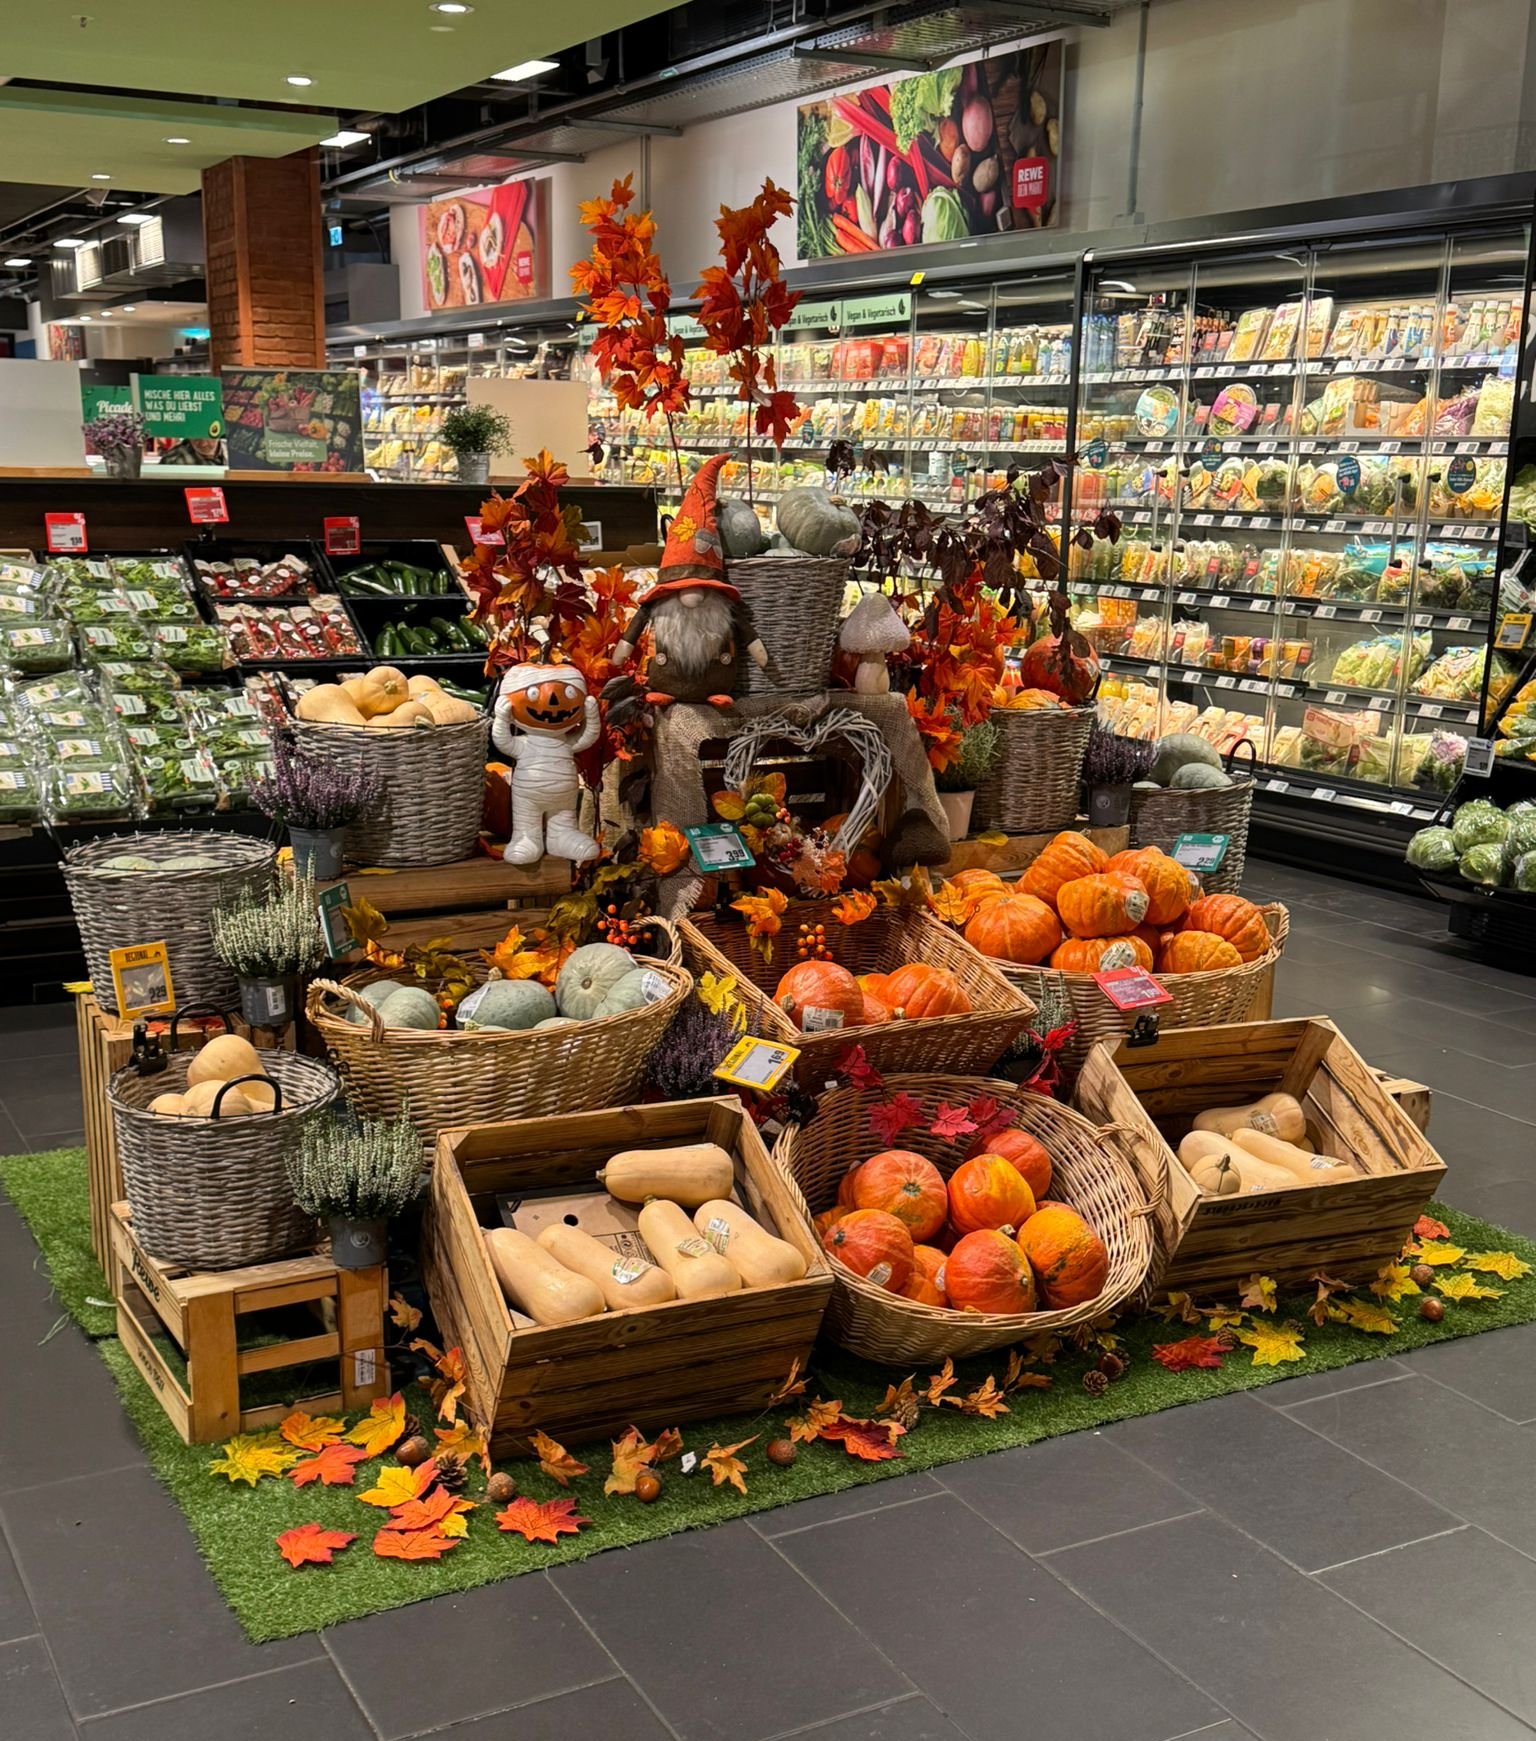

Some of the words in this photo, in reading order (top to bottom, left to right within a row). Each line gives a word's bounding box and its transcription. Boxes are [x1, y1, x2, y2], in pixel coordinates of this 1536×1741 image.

[1017, 166, 1044, 183] REWE
[144, 390, 172, 400] MISCHE
[173, 390, 190, 400] HIER
[193, 391, 215, 401] ALLES
[145, 401, 164, 411] WAS
[165, 401, 176, 411] DU
[178, 402, 203, 412] LIEBST
[145, 412, 162, 421] UND
[163, 412, 186, 422] MEHR!
[268, 439, 293, 448] Frische
